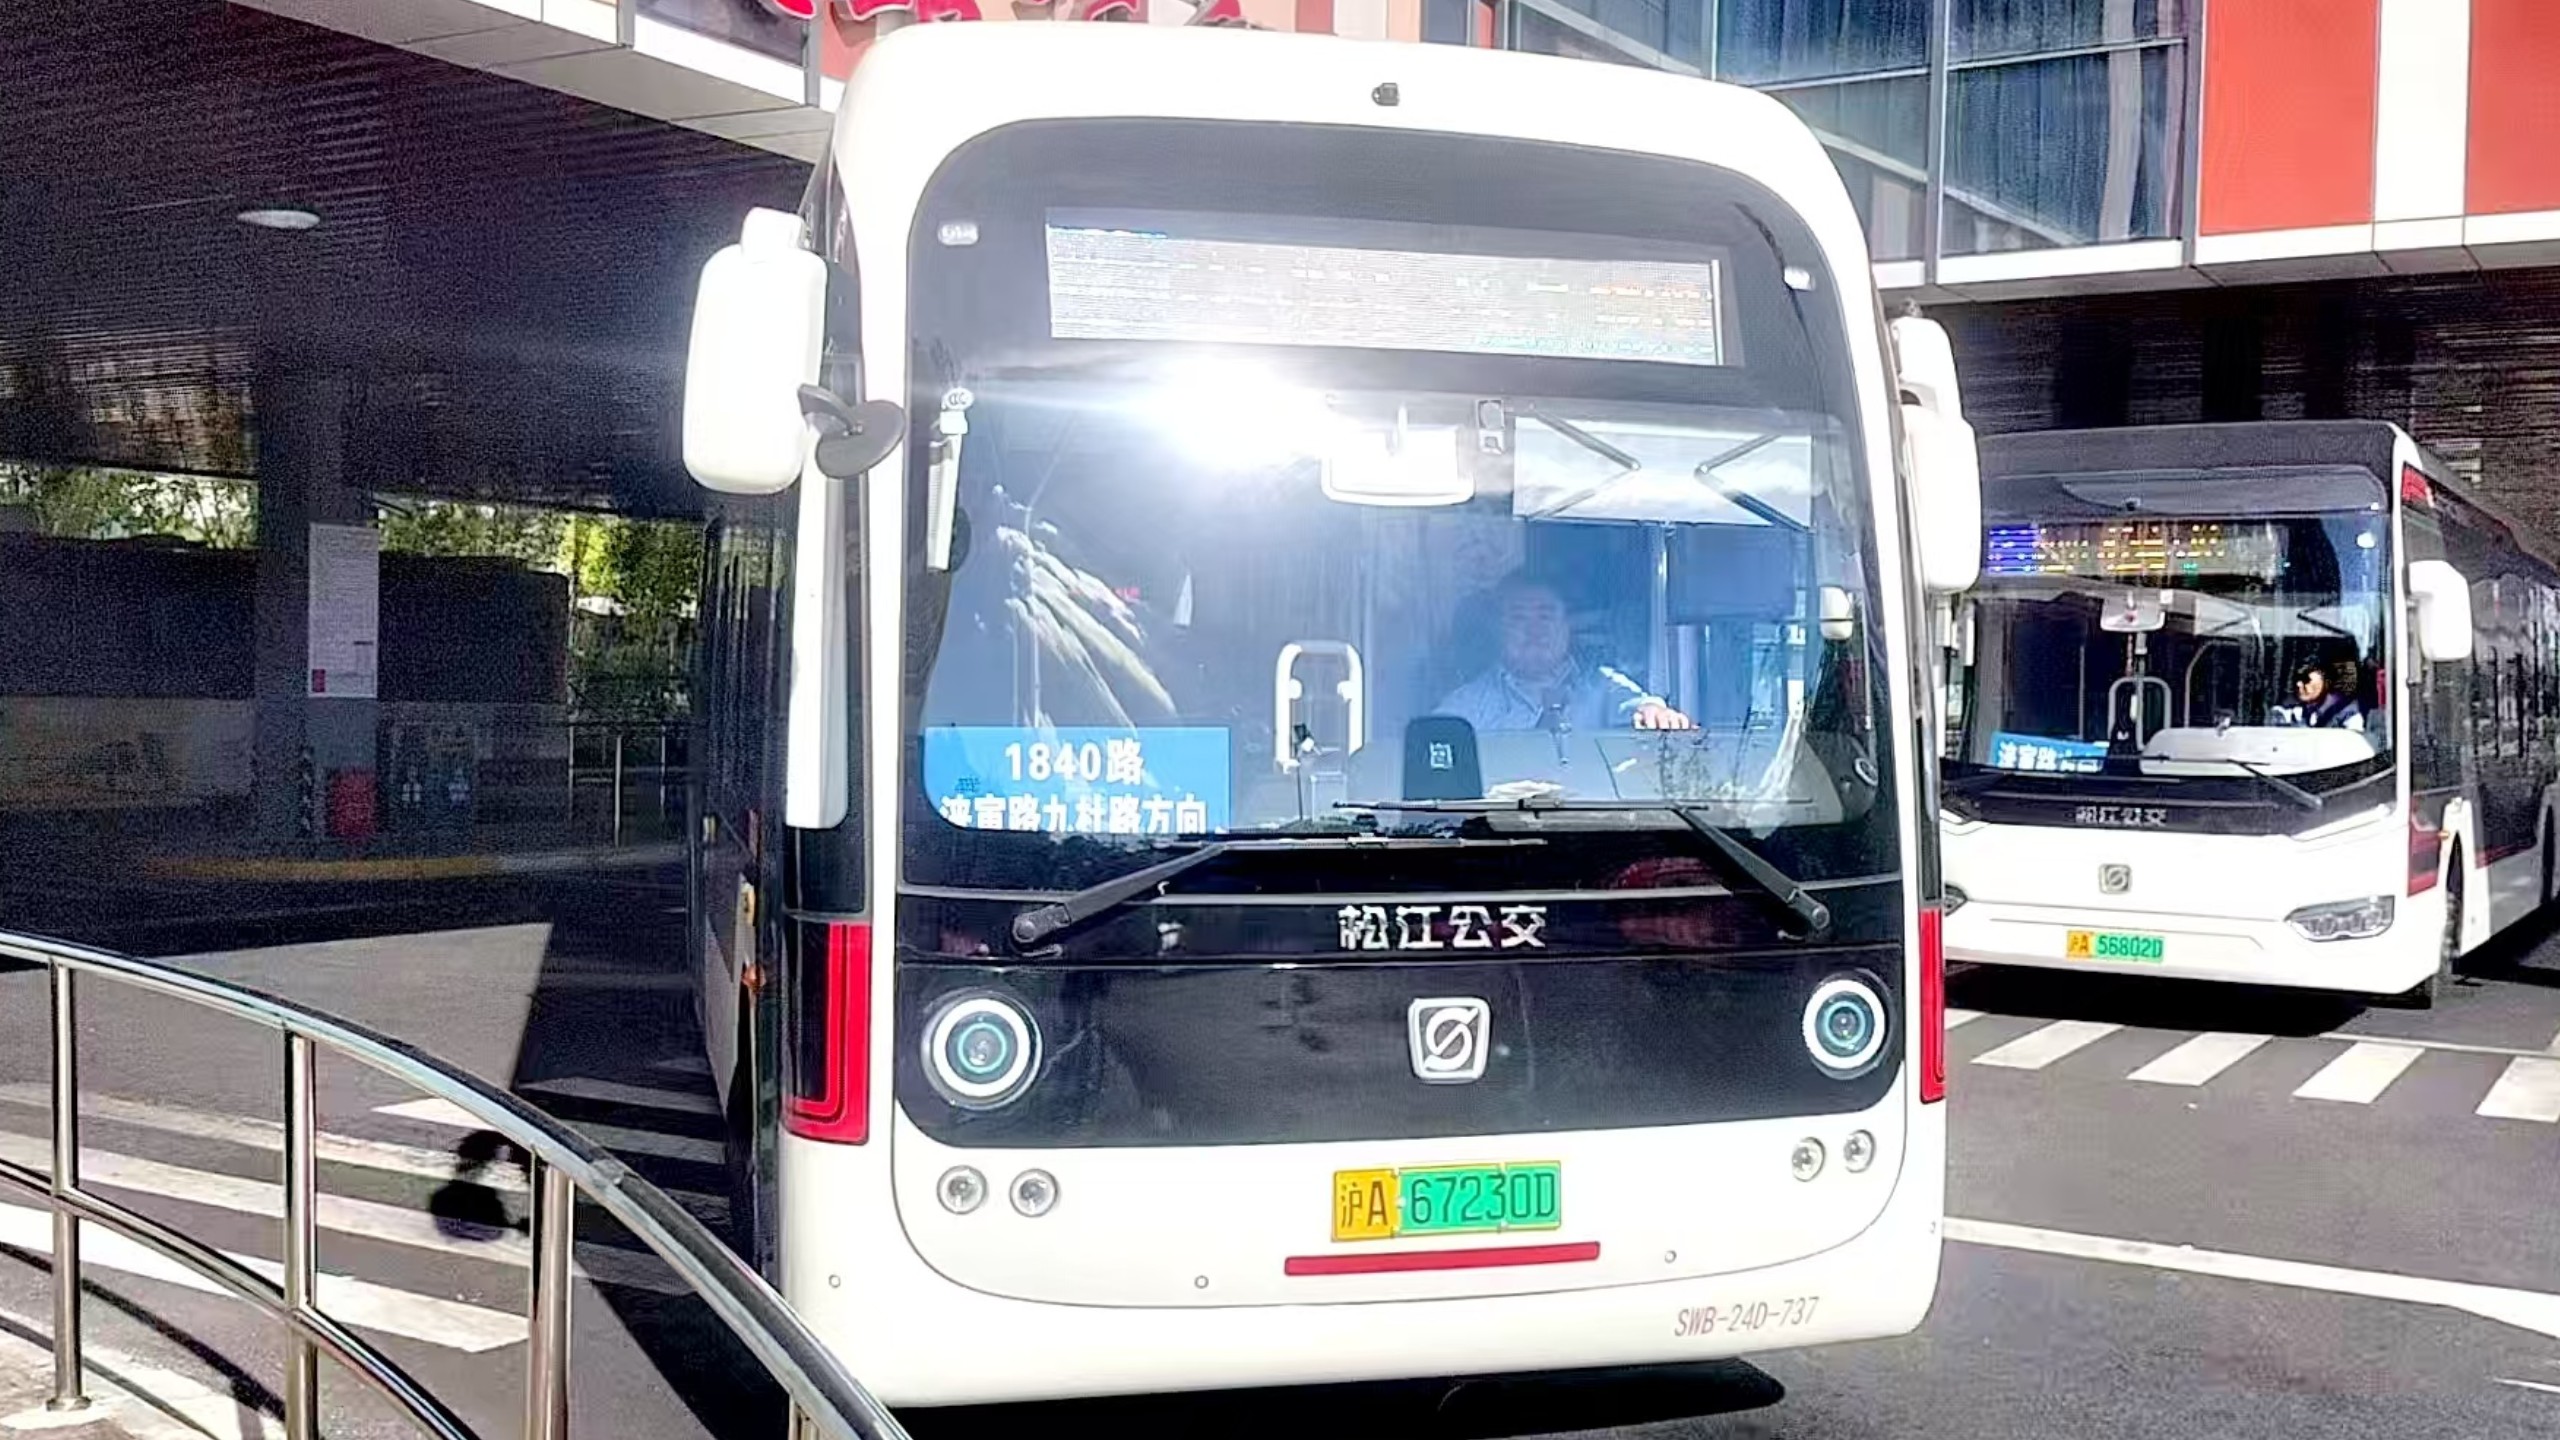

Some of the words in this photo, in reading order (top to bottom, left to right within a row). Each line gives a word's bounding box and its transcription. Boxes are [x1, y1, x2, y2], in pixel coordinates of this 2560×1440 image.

[1004, 738, 1144, 785] 1840路
[1338, 904, 1547, 950] 松江公交
[1674, 1295, 1820, 1337] SWB-24D-737
